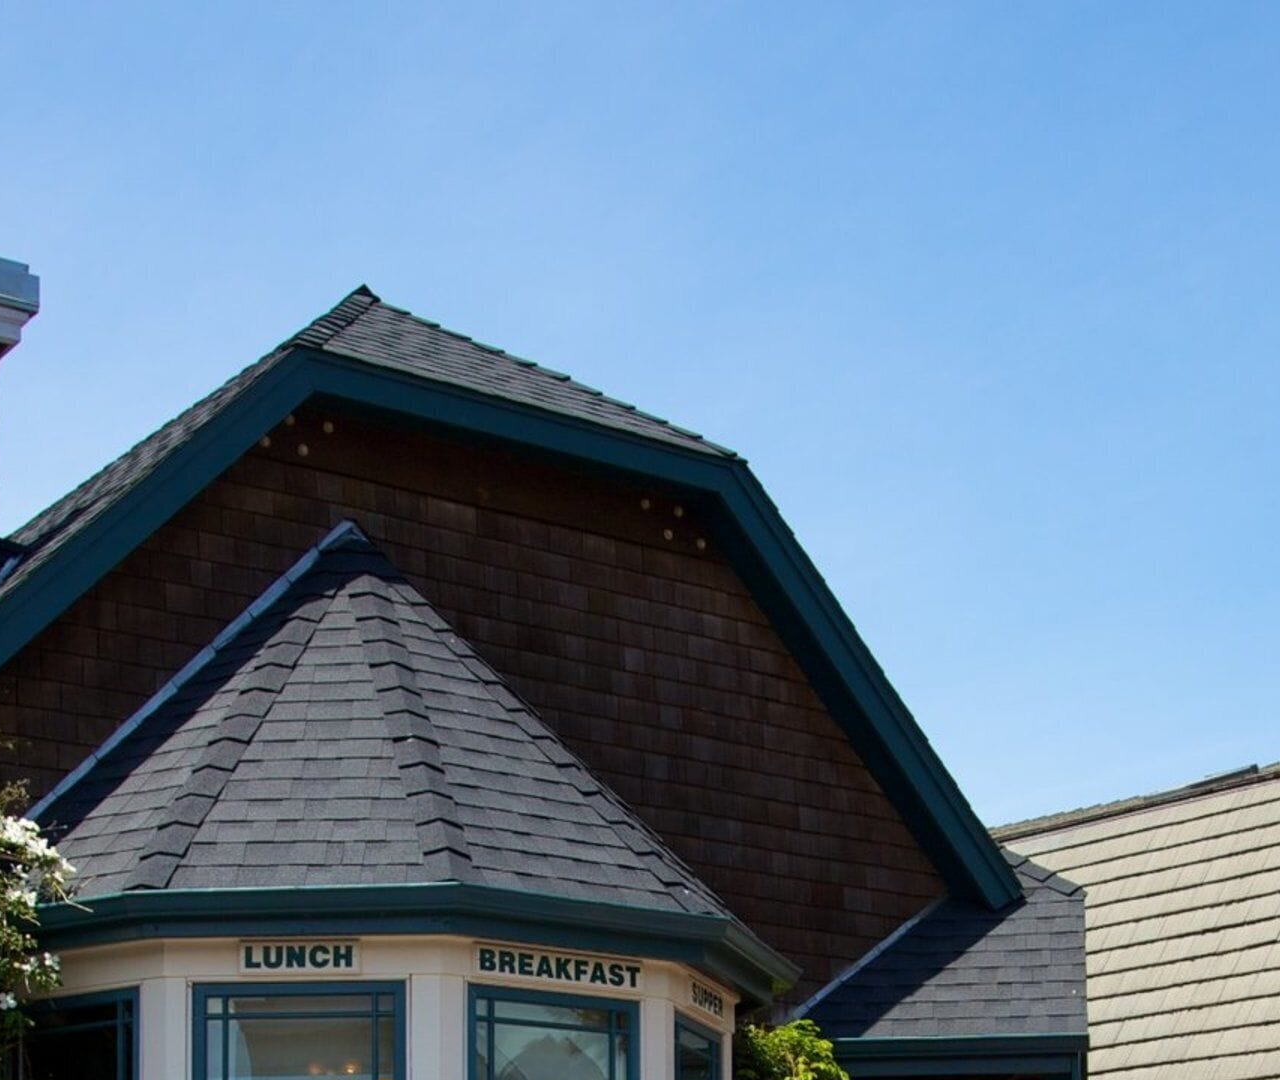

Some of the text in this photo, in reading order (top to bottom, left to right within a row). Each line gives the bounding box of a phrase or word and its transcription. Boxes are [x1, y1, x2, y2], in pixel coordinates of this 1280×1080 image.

[244, 945, 353, 968] LUNCH
[478, 949, 641, 988] BREAKFAST
[691, 981, 724, 1016] SUPPER
